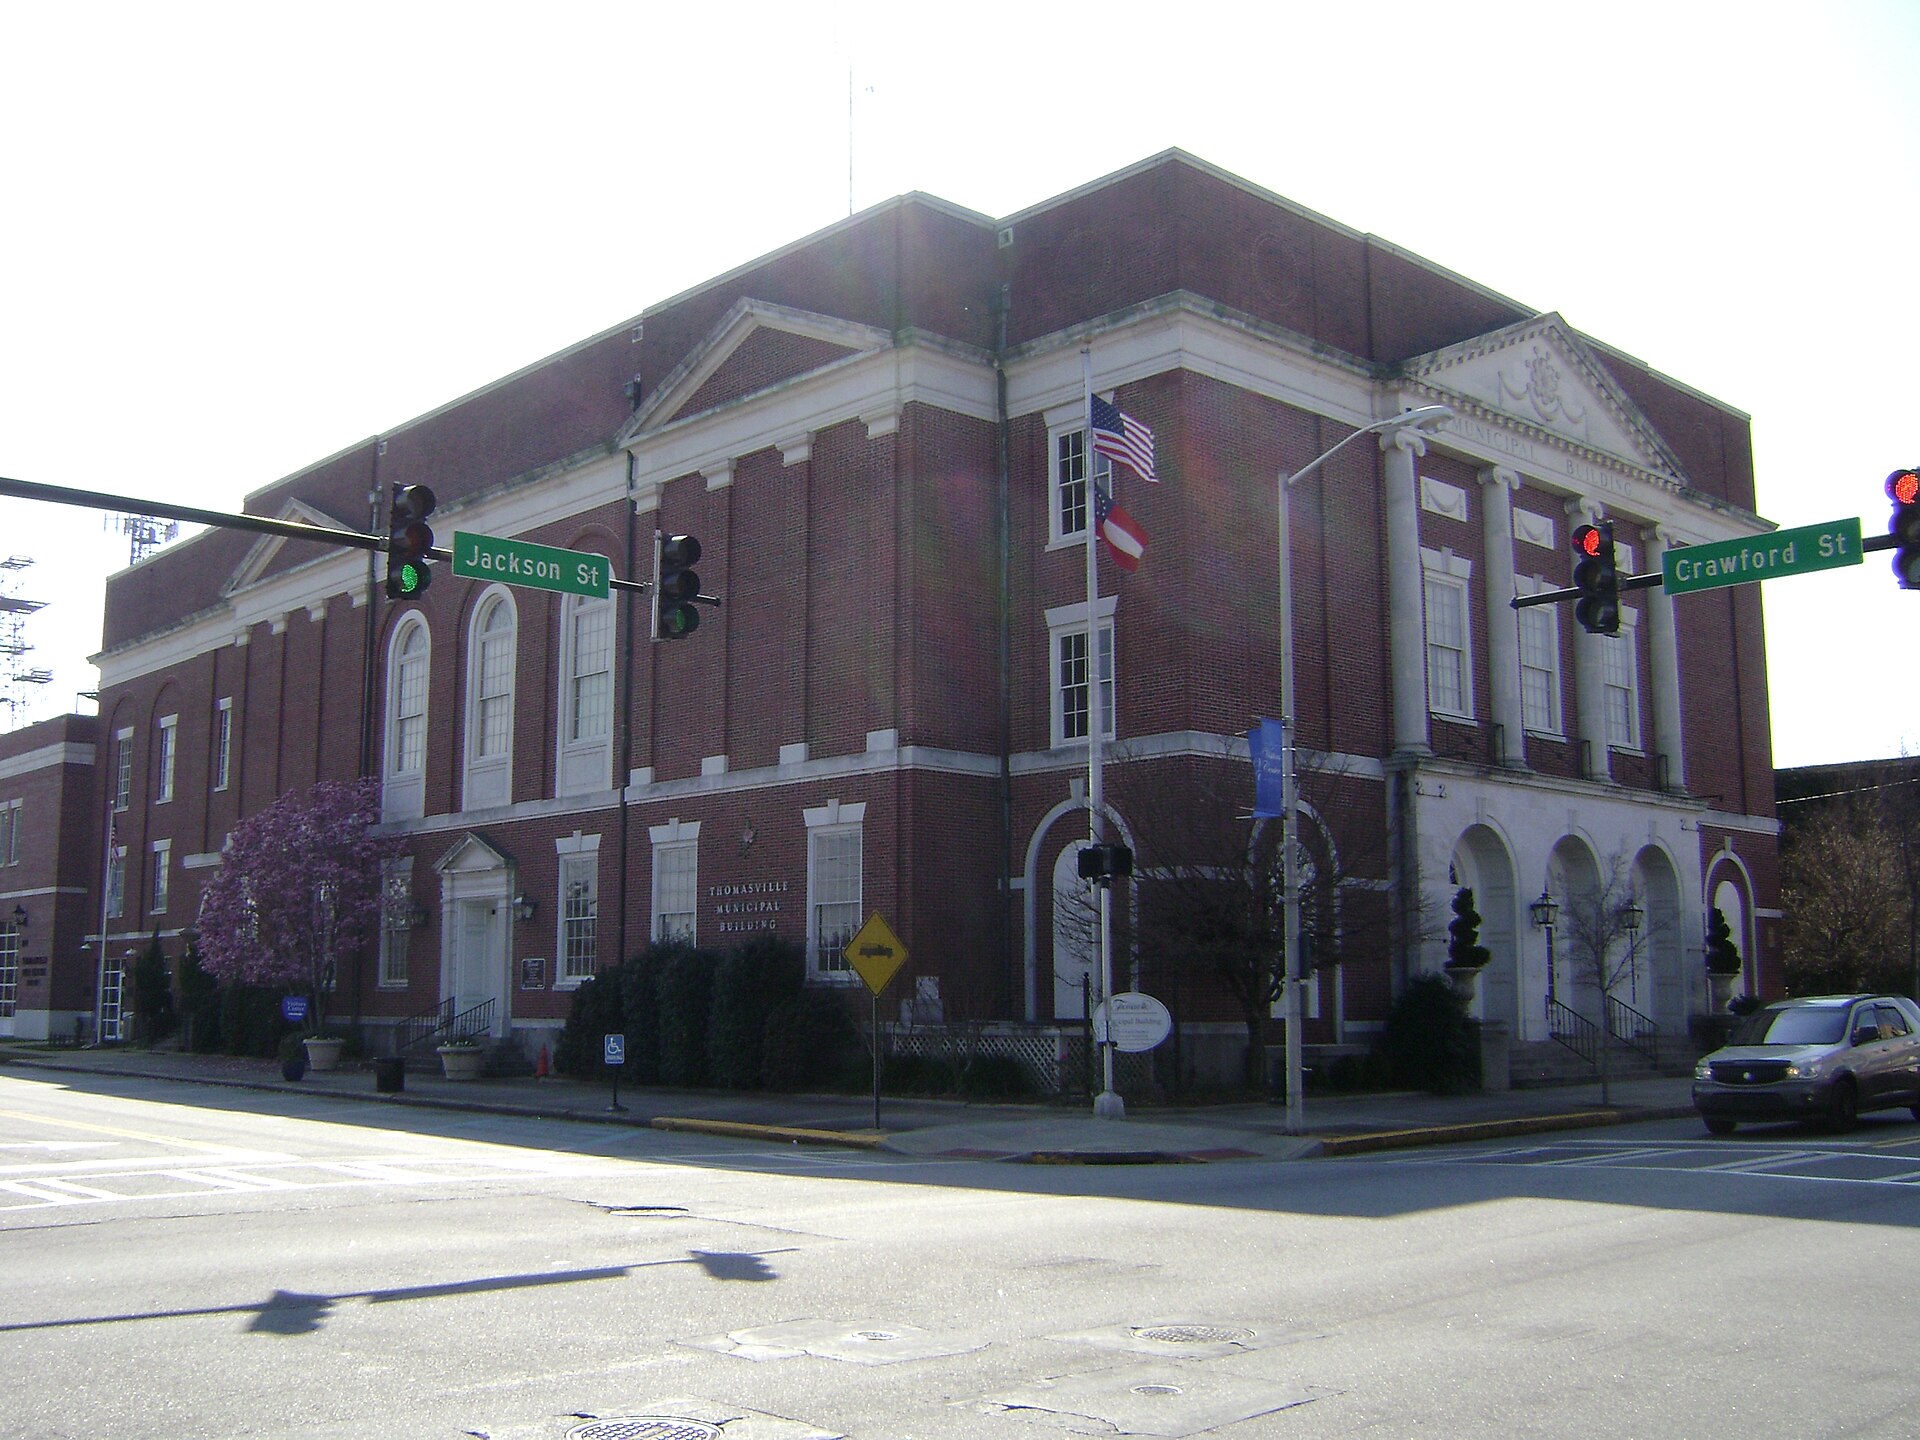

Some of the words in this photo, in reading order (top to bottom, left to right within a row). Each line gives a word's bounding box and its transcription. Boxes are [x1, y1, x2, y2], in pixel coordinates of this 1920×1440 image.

[1453, 418, 1537, 461] MUNICIPAL
[1565, 458, 1633, 497] BUILDING
[465, 544, 561, 580] Jackson
[576, 563, 599, 587] St
[1674, 541, 1795, 582] Crawford
[1817, 532, 1848, 558] St
[709, 881, 789, 896] THOMASVILLE
[715, 901, 780, 914] MUNICIPAL
[720, 919, 776, 932] BUILDING
